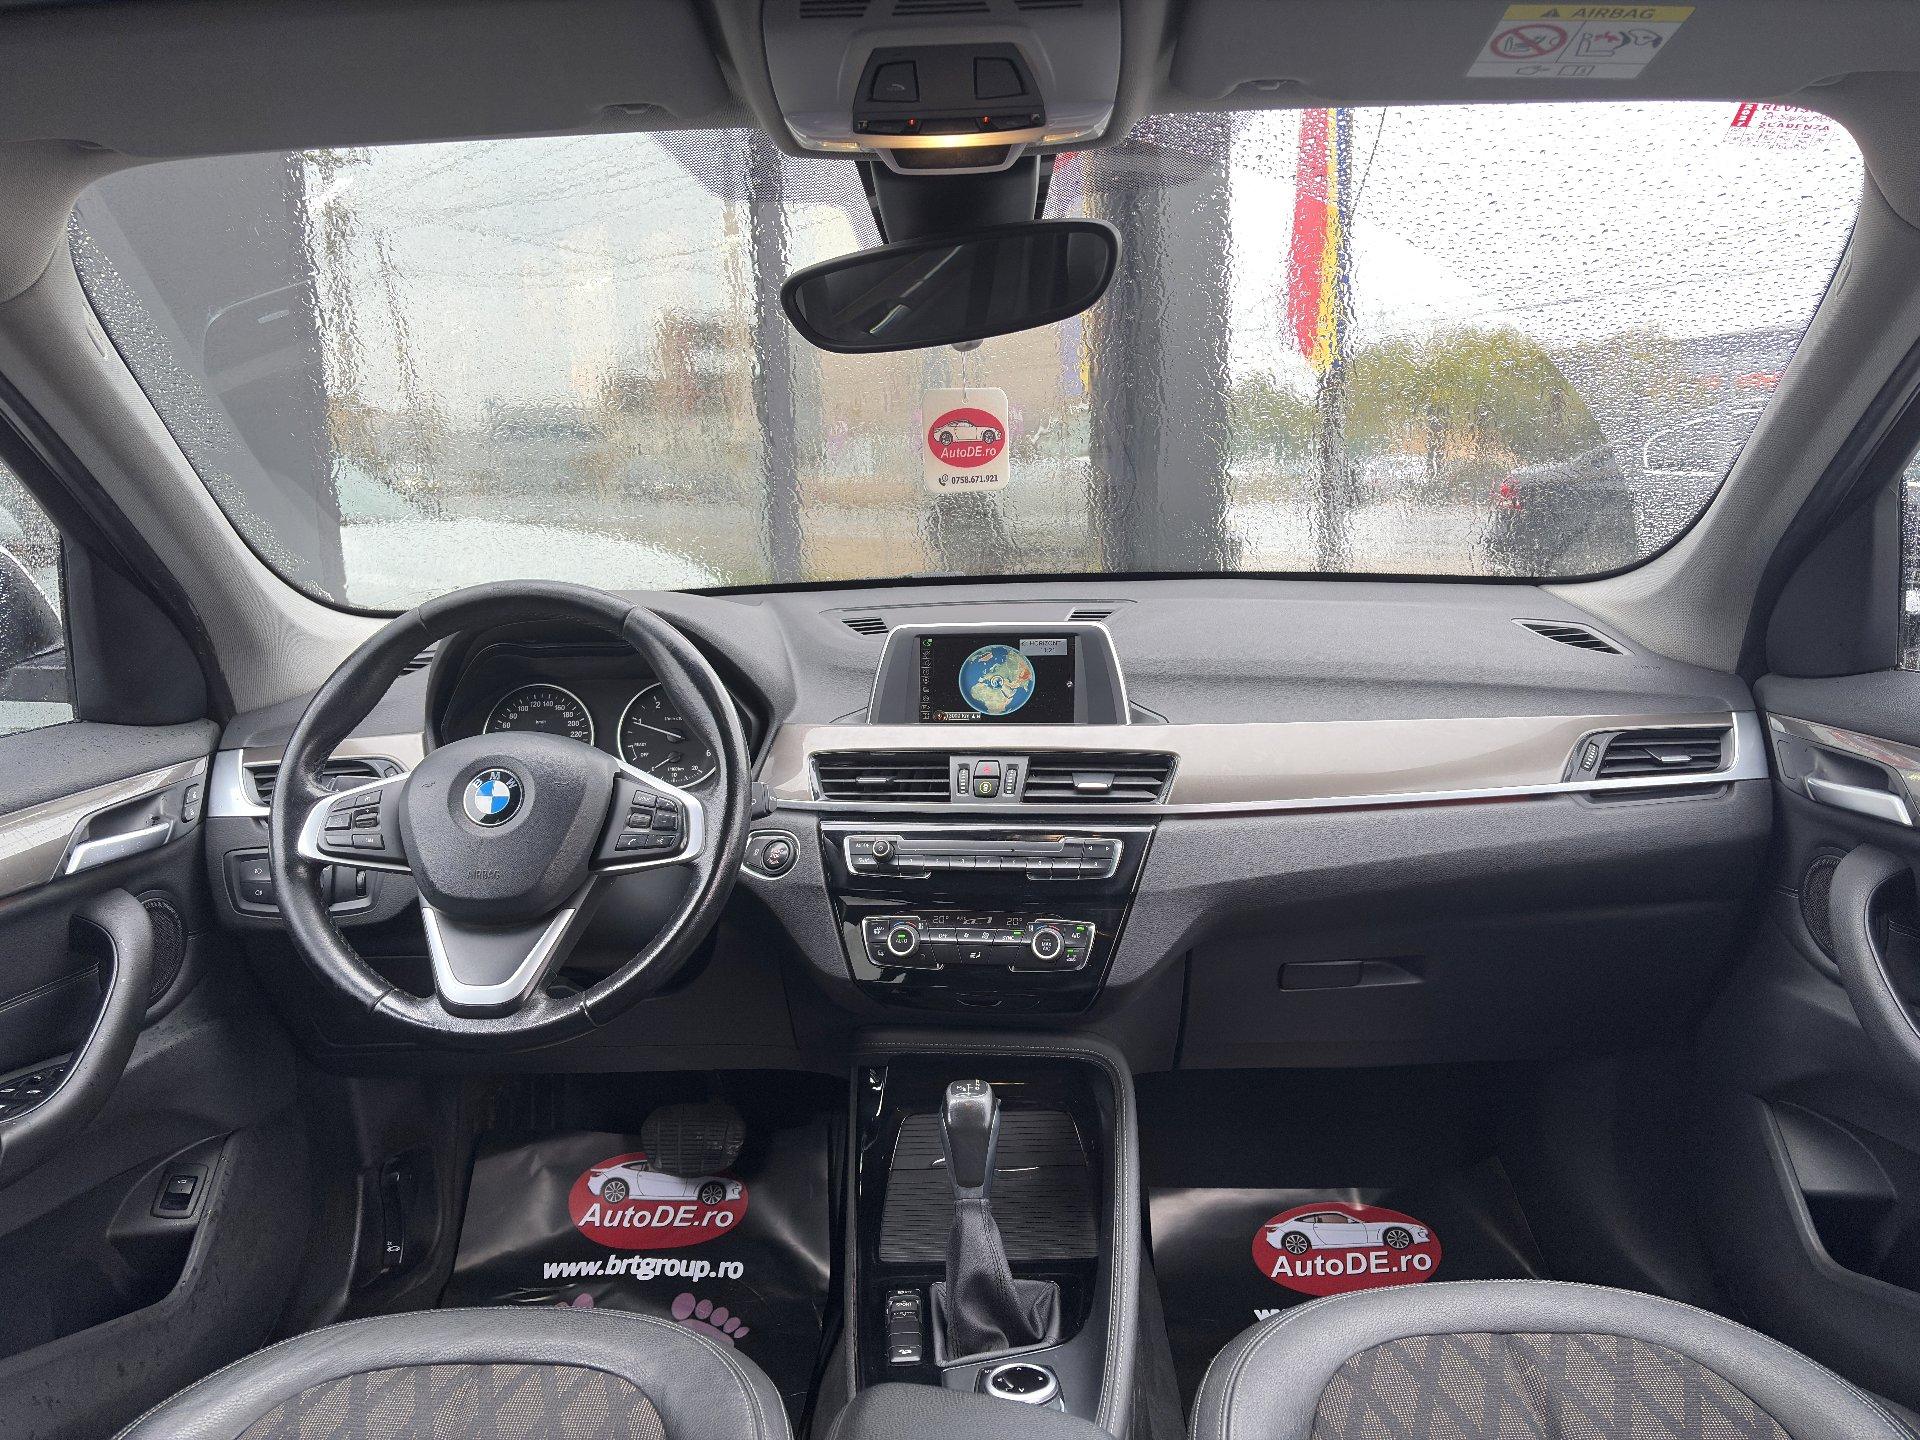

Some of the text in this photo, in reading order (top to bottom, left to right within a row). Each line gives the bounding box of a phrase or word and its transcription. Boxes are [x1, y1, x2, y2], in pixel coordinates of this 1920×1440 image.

[1571, 7, 1656, 19] AIRBAG
[940, 445, 997, 459] AutoDE.ro
[951, 474, 998, 485] 0758.671.921
[655, 701, 661, 709] 2
[706, 749, 712, 757] 6
[472, 771, 518, 790] BMW
[578, 1203, 734, 1228] AutoDE.ro
[543, 1254, 744, 1283] www.brtgroup.ro
[1270, 1251, 1432, 1278] AutoDE.ro
